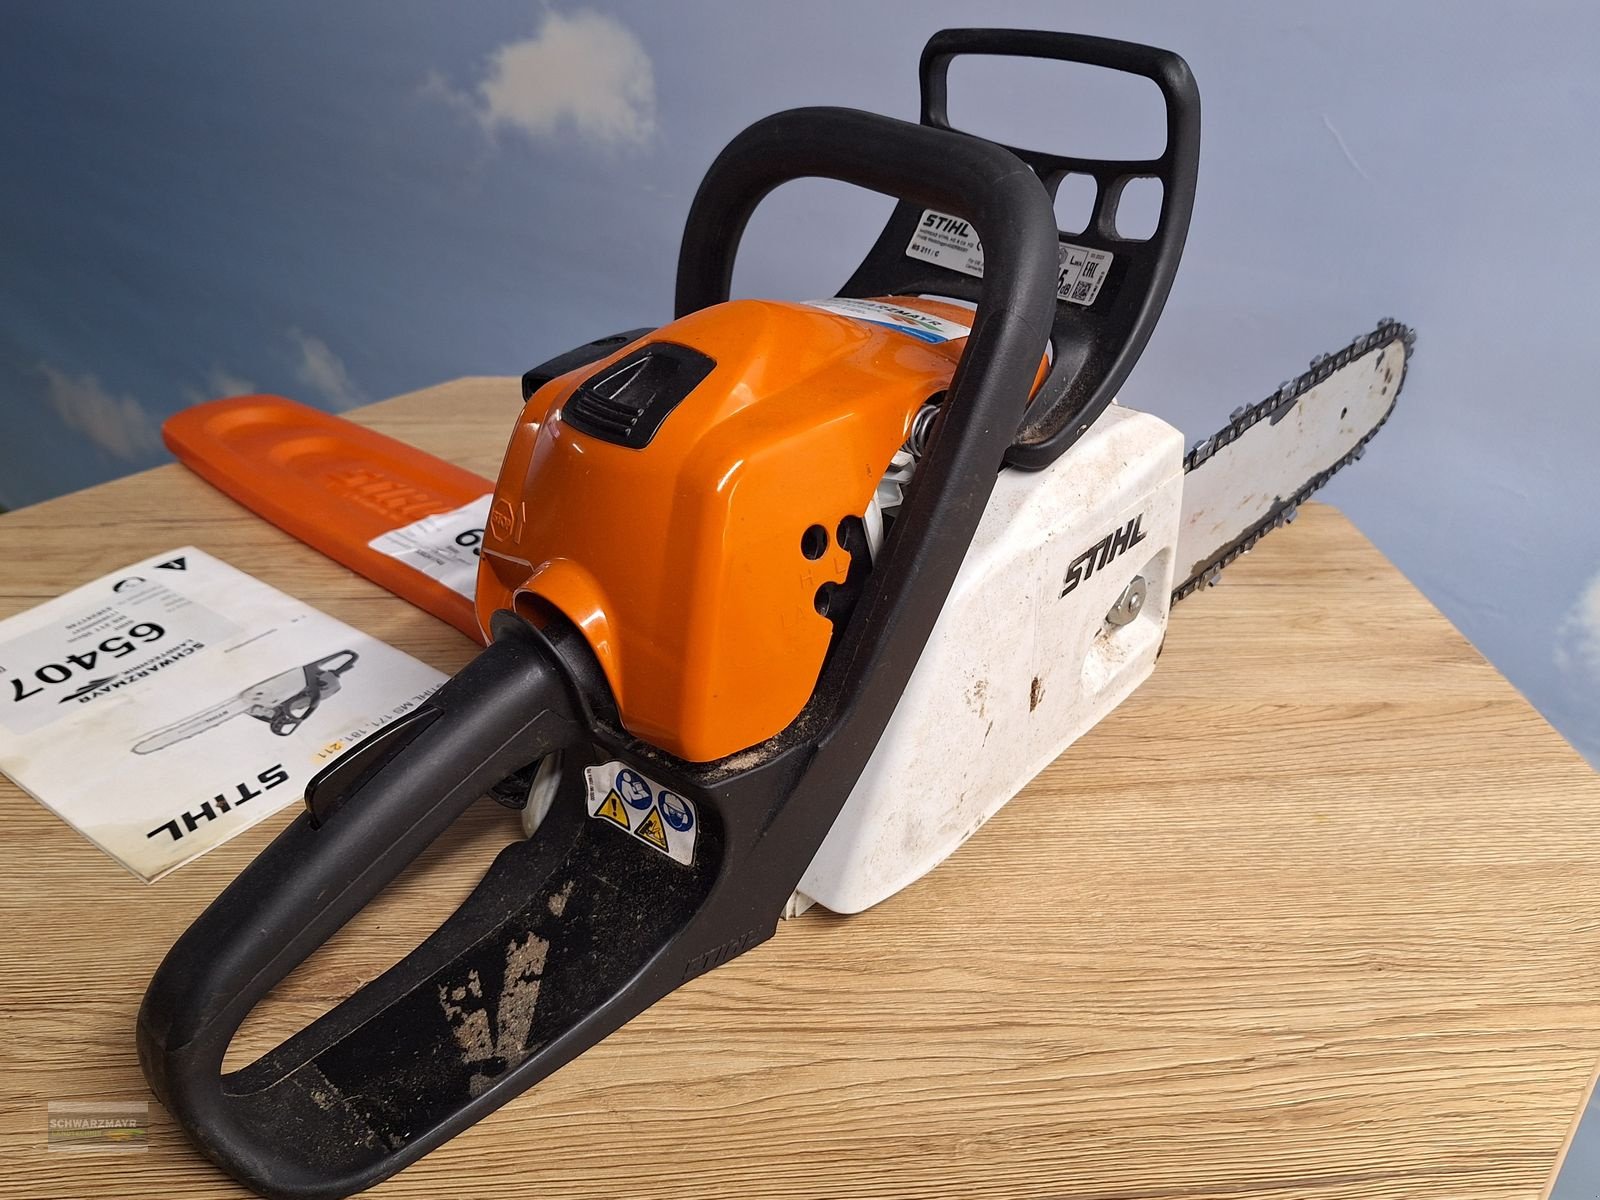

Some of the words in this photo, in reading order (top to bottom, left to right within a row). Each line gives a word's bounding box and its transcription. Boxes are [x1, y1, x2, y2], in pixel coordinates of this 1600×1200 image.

[923, 214, 969, 238] STIHL
[1058, 512, 1148, 599] STIHL
[11, 623, 165, 702] 65407
[78, 641, 205, 704] SCHWARZMAYR
[318, 742, 342, 759] 211
[147, 763, 289, 841] STIHL
